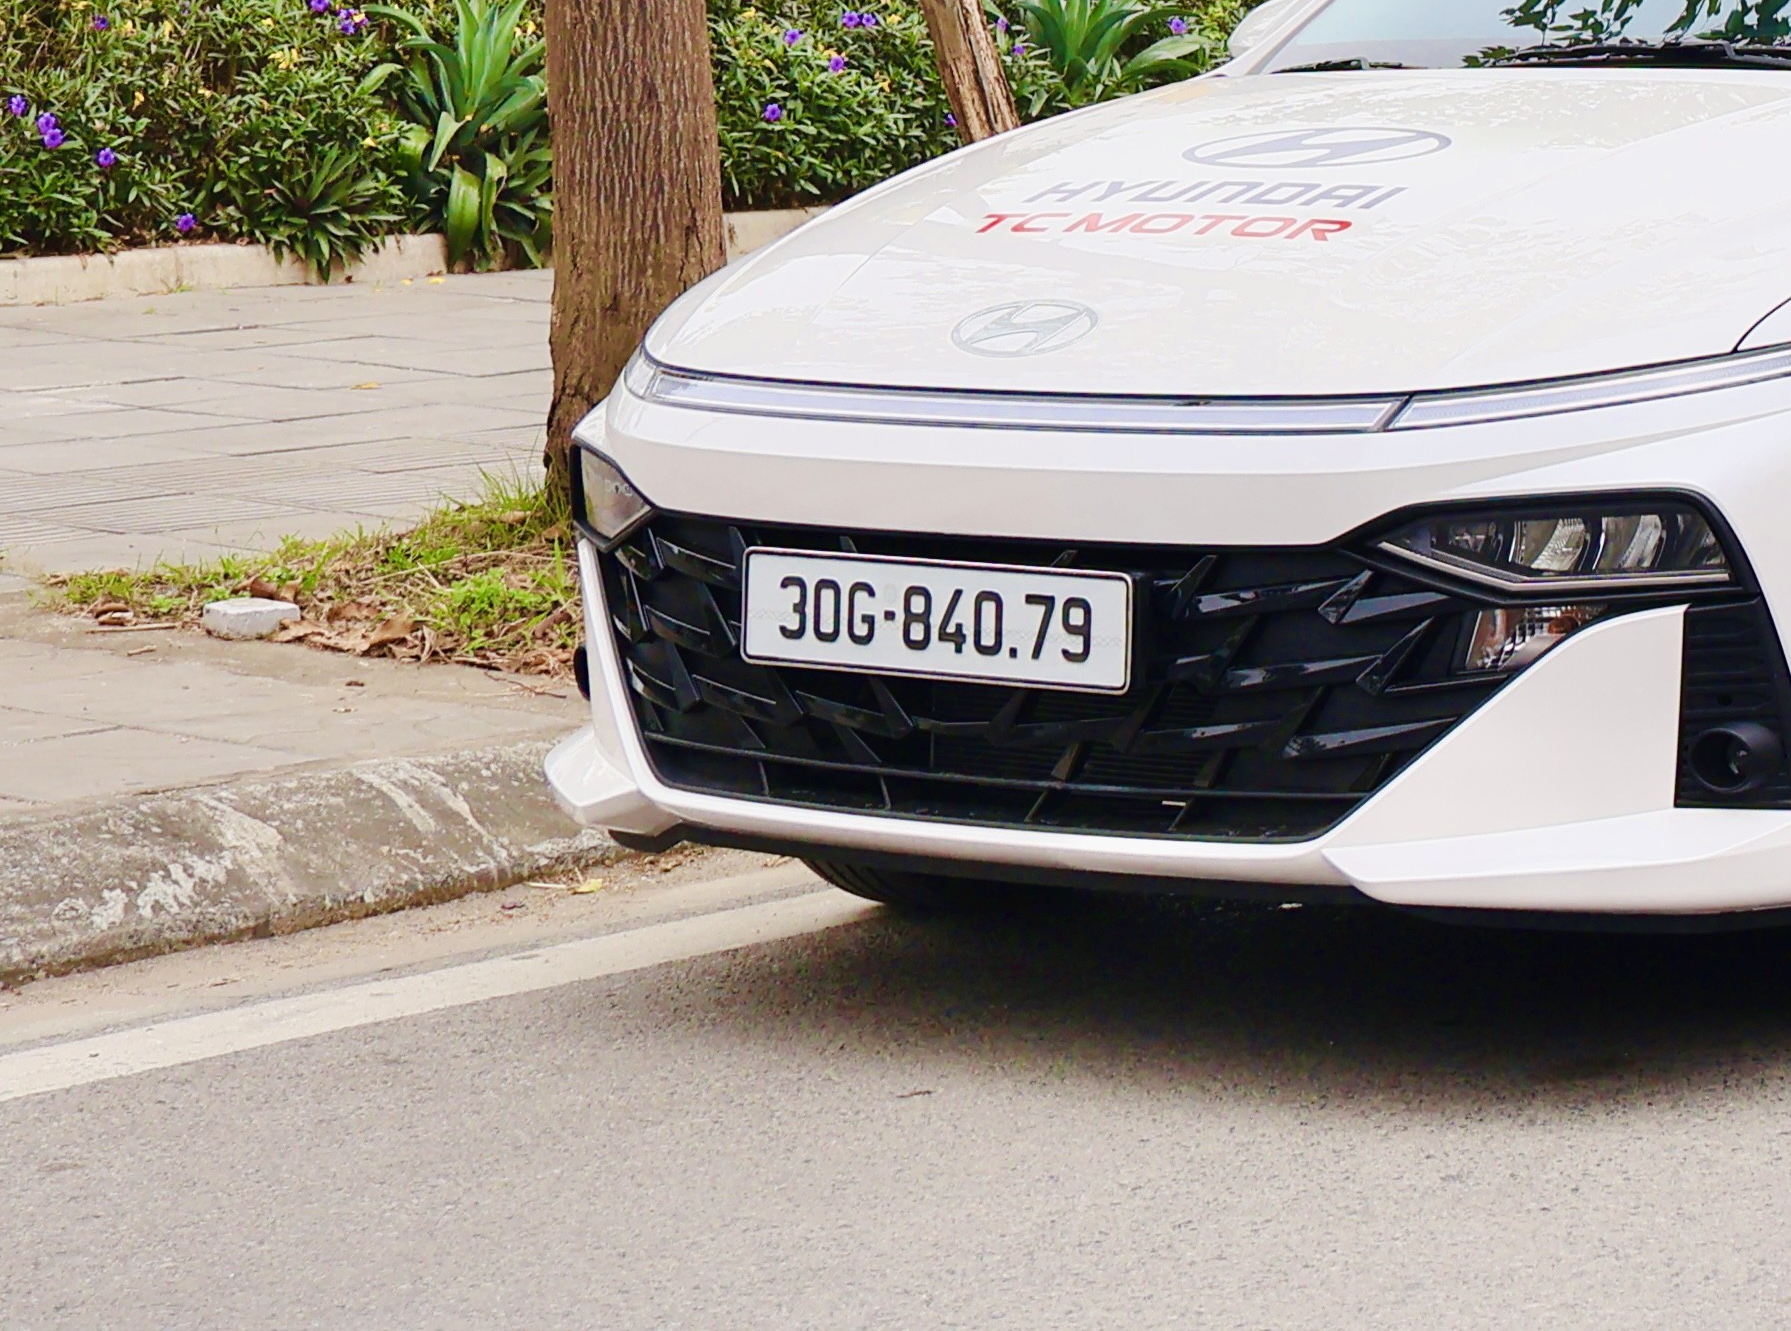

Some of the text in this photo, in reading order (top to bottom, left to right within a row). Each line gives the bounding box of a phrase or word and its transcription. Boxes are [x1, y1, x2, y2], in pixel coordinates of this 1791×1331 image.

[1023, 180, 1409, 209] HYUNDAI
[975, 212, 1353, 242] TC MOTOR
